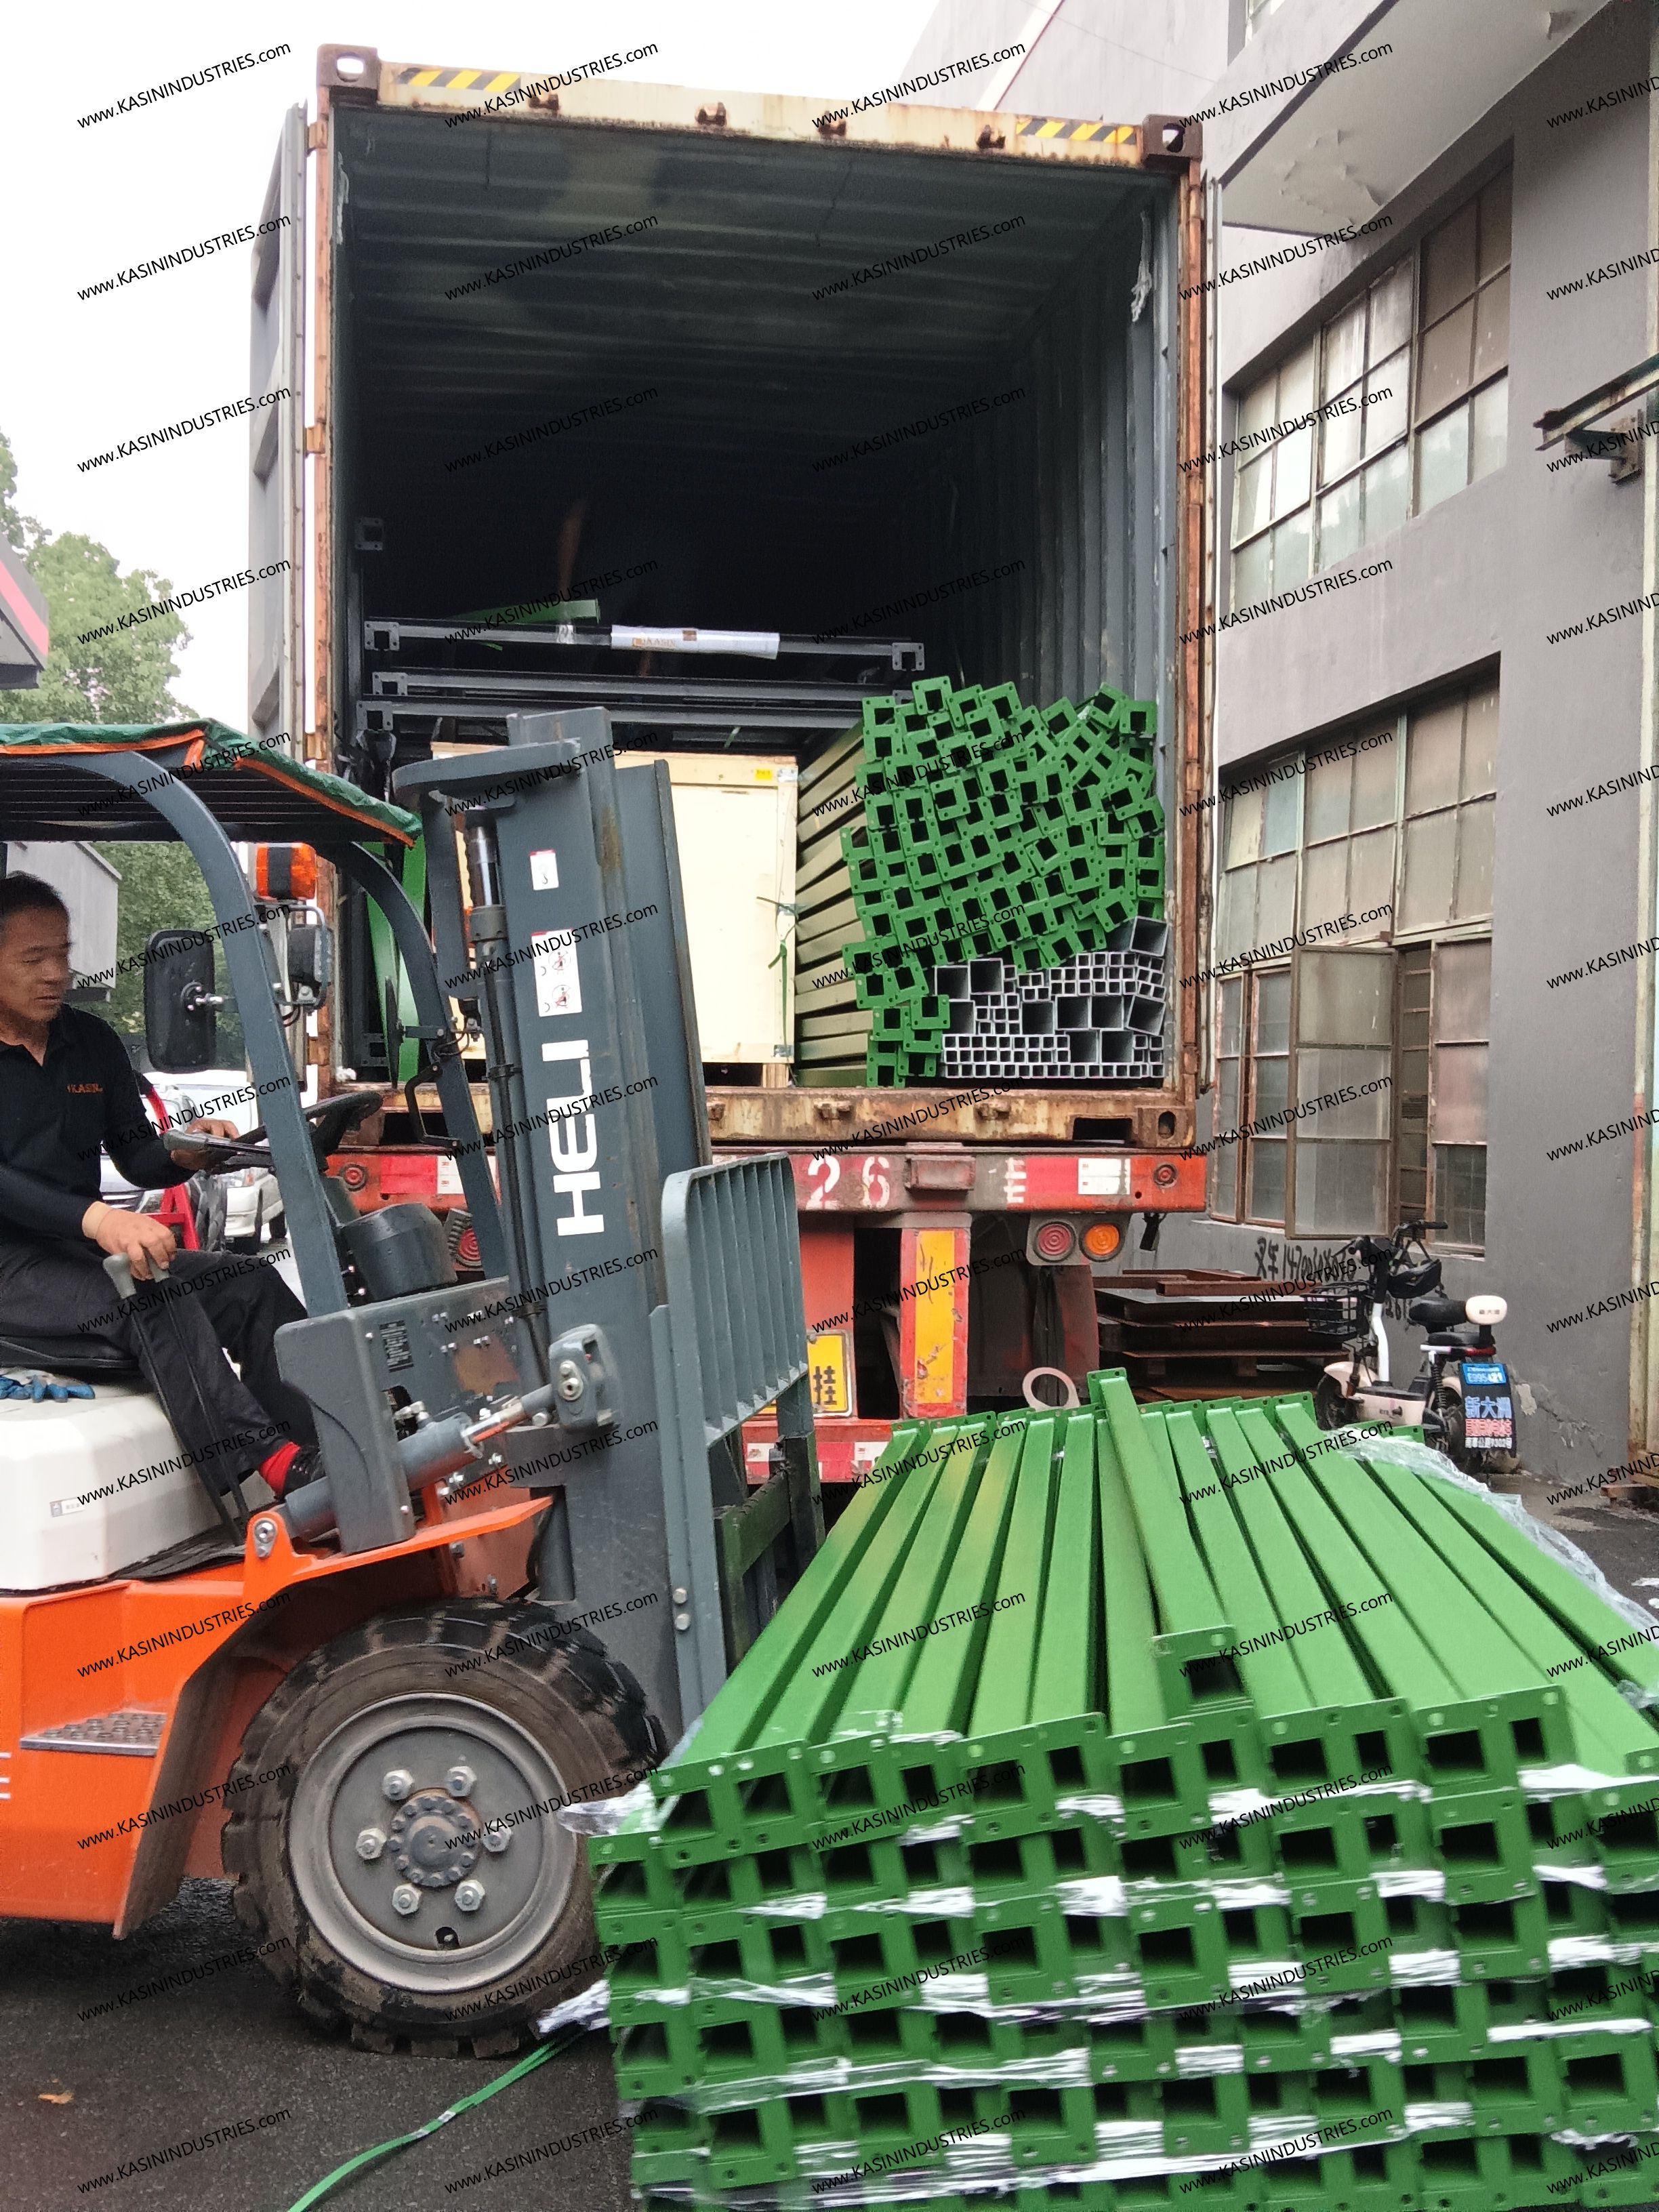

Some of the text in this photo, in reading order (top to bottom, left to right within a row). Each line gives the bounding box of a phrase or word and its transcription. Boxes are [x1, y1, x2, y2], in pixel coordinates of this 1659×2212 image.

[542, 1040, 605, 1236] HELI
[813, 1365, 838, 1406] 挂
[1465, 1396, 1512, 1418] 新大洲
